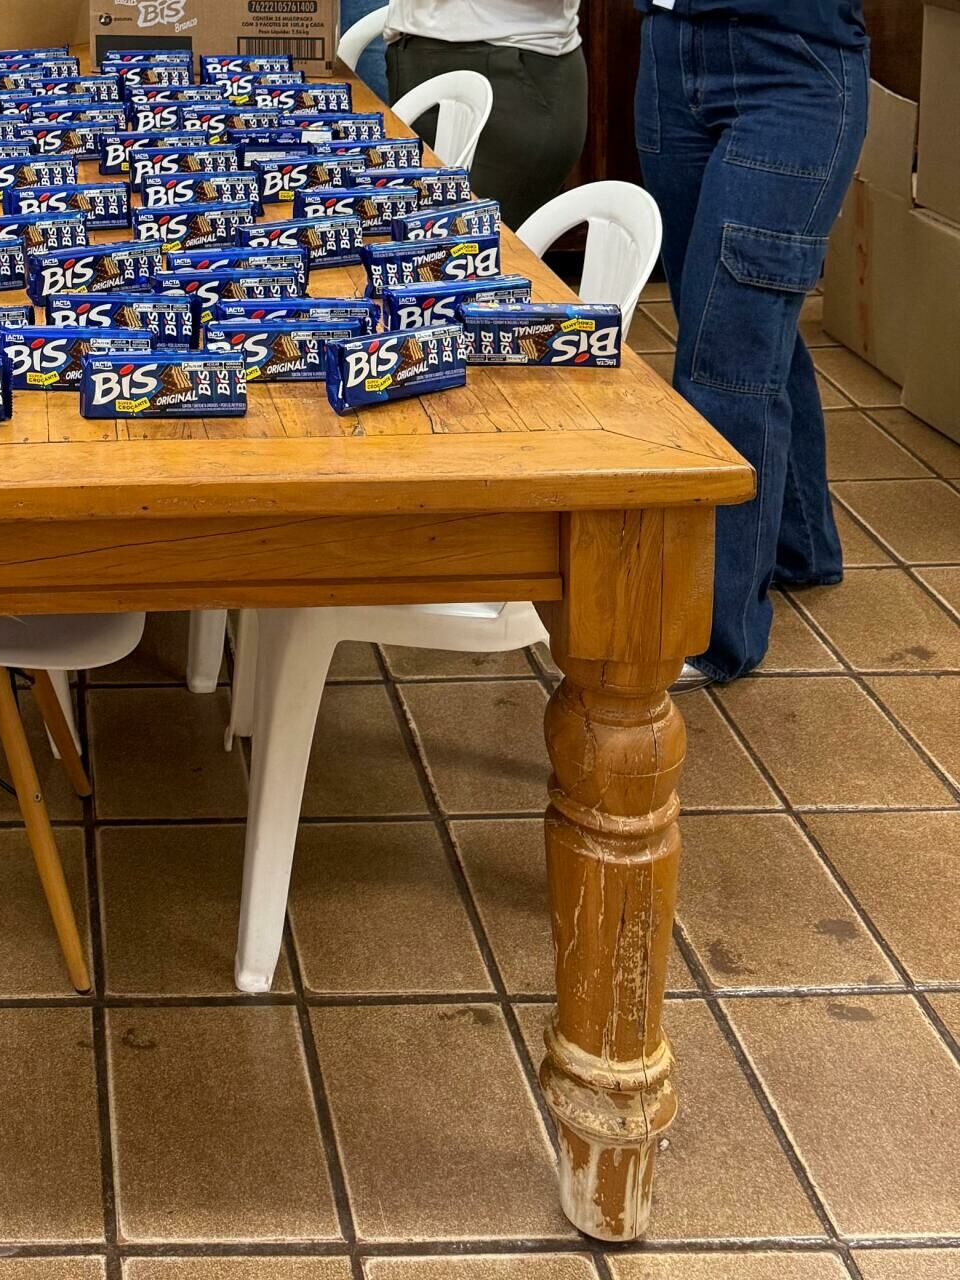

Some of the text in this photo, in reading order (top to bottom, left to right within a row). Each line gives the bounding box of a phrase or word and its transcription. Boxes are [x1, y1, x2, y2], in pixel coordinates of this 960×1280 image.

[186, 235, 216, 247] ORIGINAL
[93, 276, 124, 291] ORIGINAL
[53, 300, 71, 308] LACTA
[399, 296, 416, 304] LACTA
[513, 324, 554, 337] ORIGINAL
[6, 334, 24, 342] LACTA
[267, 359, 307, 375] ORIGINAL
[596, 358, 617, 366] LACTA
[66, 370, 82, 380] ORIG
[396, 363, 428, 381] ORIGINAL
[157, 391, 198, 406] ORIGINAL
